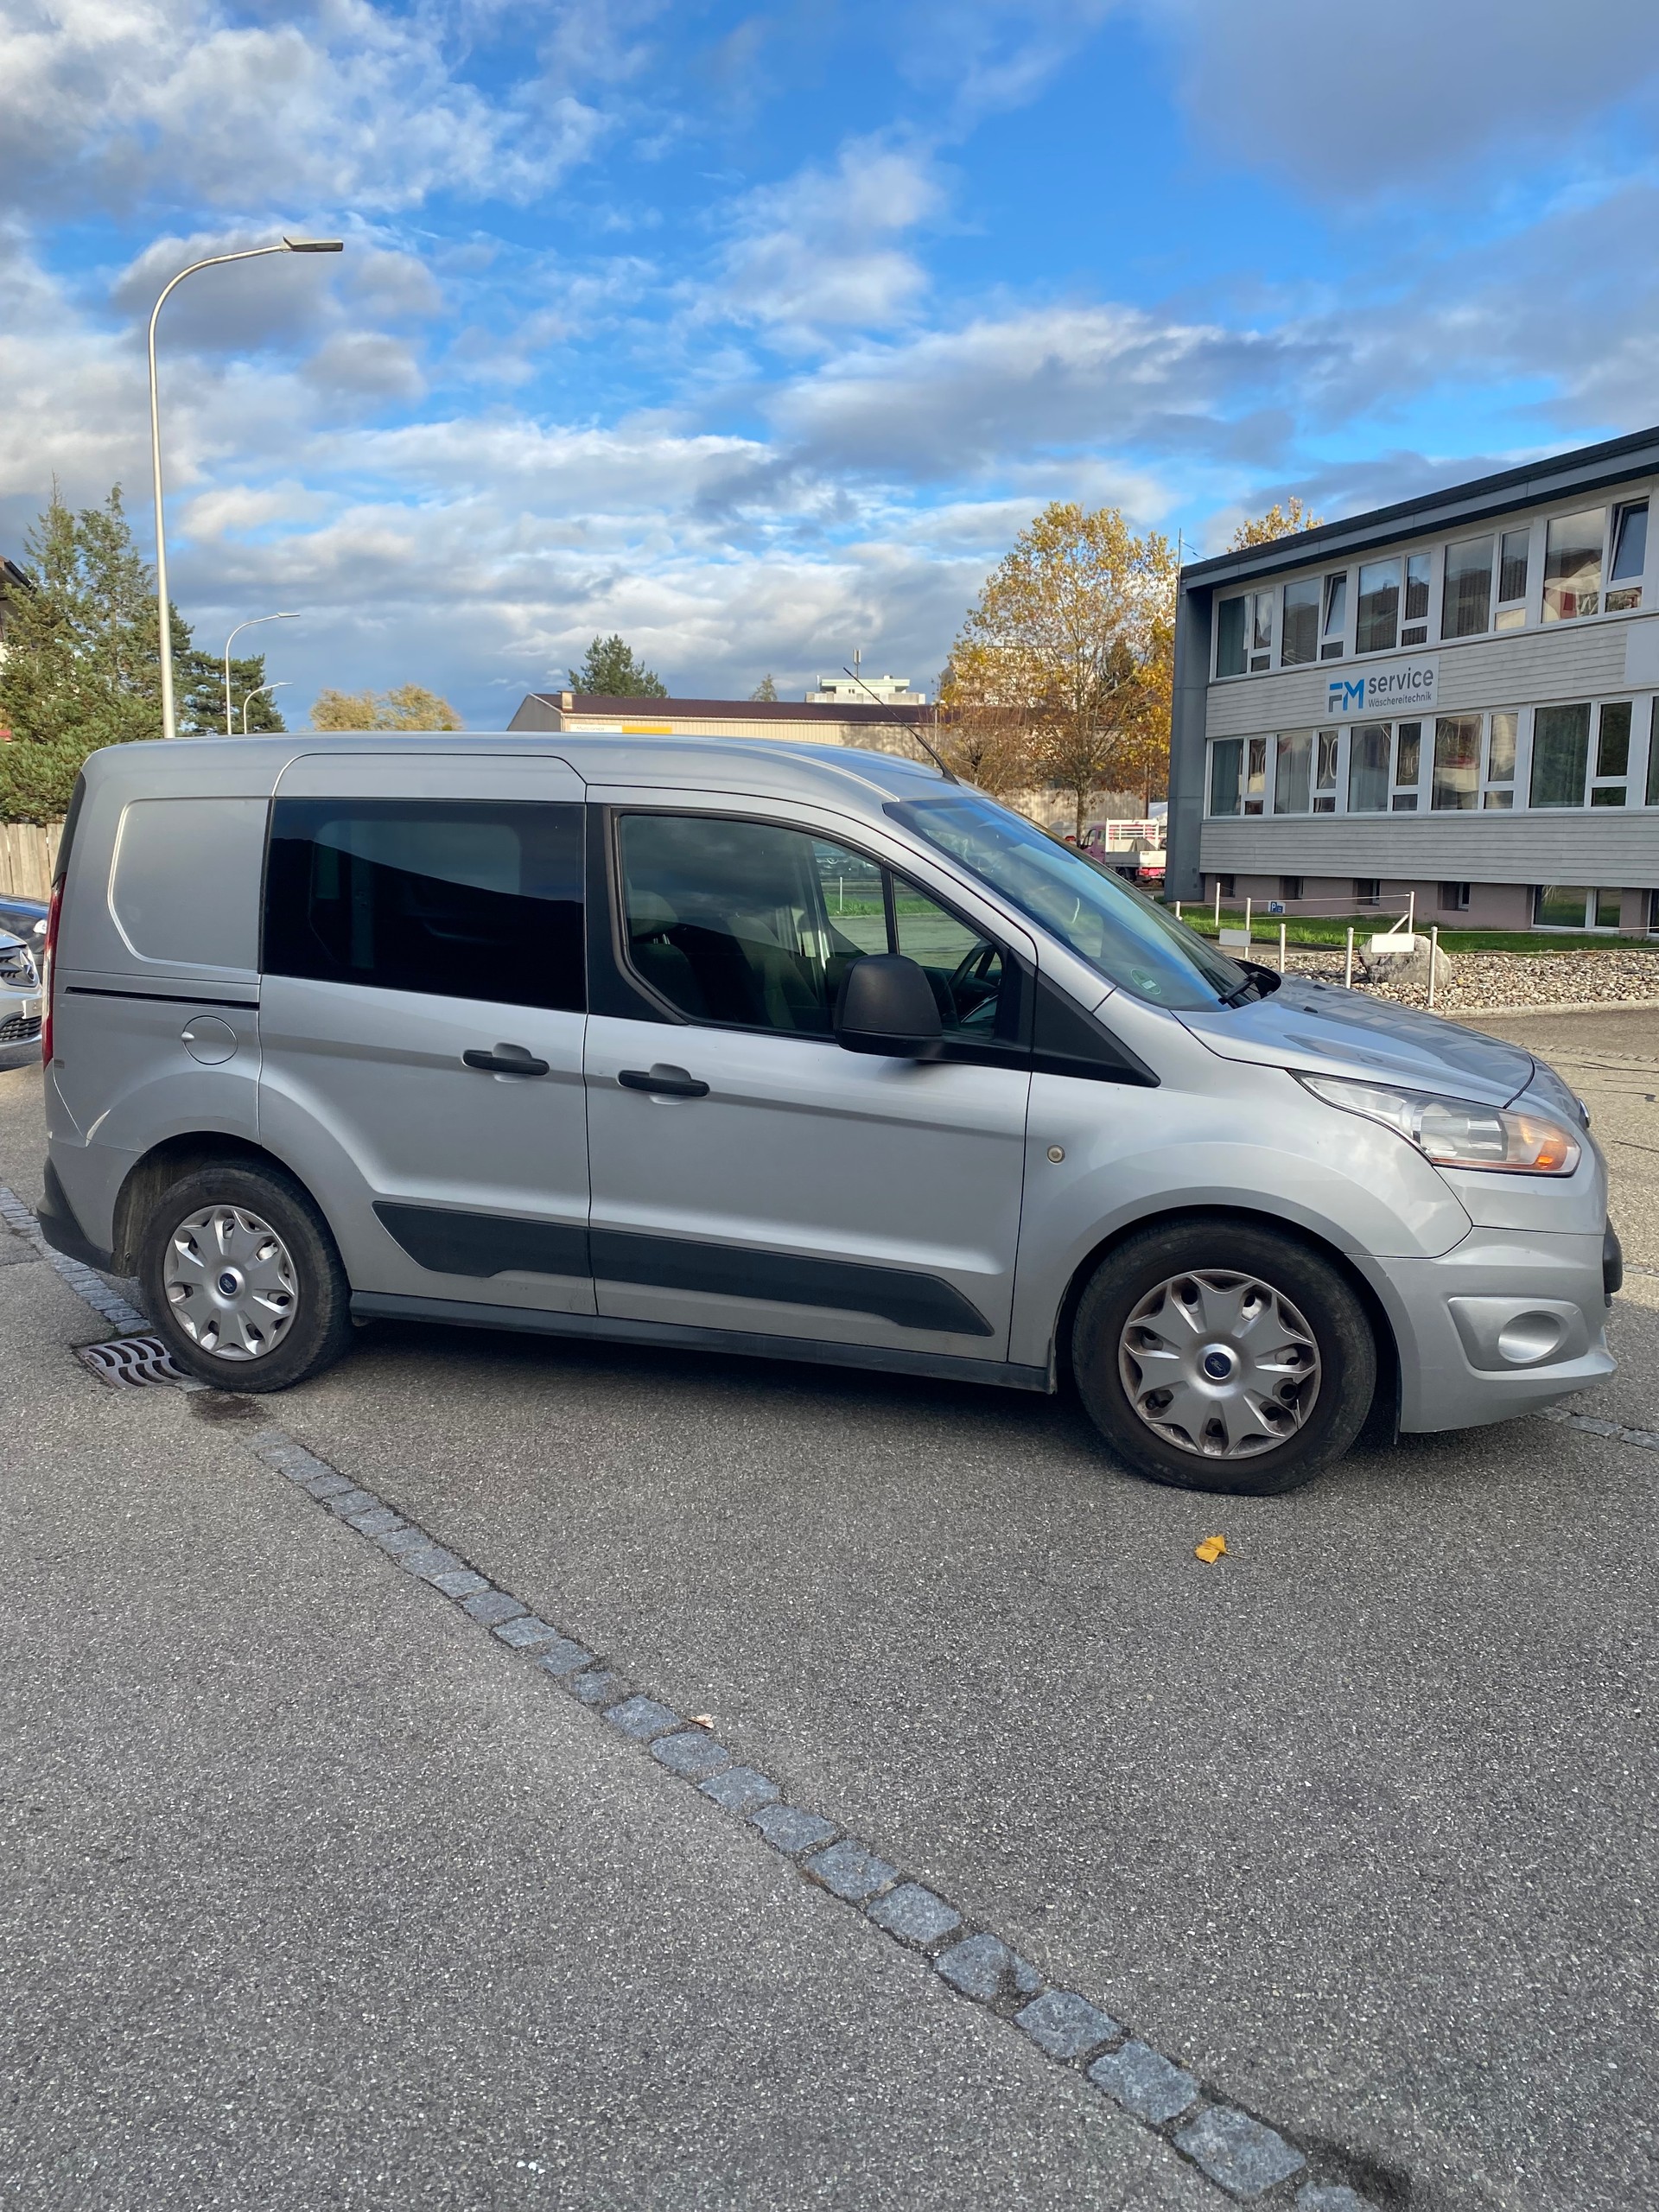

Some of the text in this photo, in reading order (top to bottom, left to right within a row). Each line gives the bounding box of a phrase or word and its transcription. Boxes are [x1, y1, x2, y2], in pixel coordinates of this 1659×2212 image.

[1328, 667, 1433, 713] FM service
[1368, 691, 1432, 708] Wäschereitechnik
